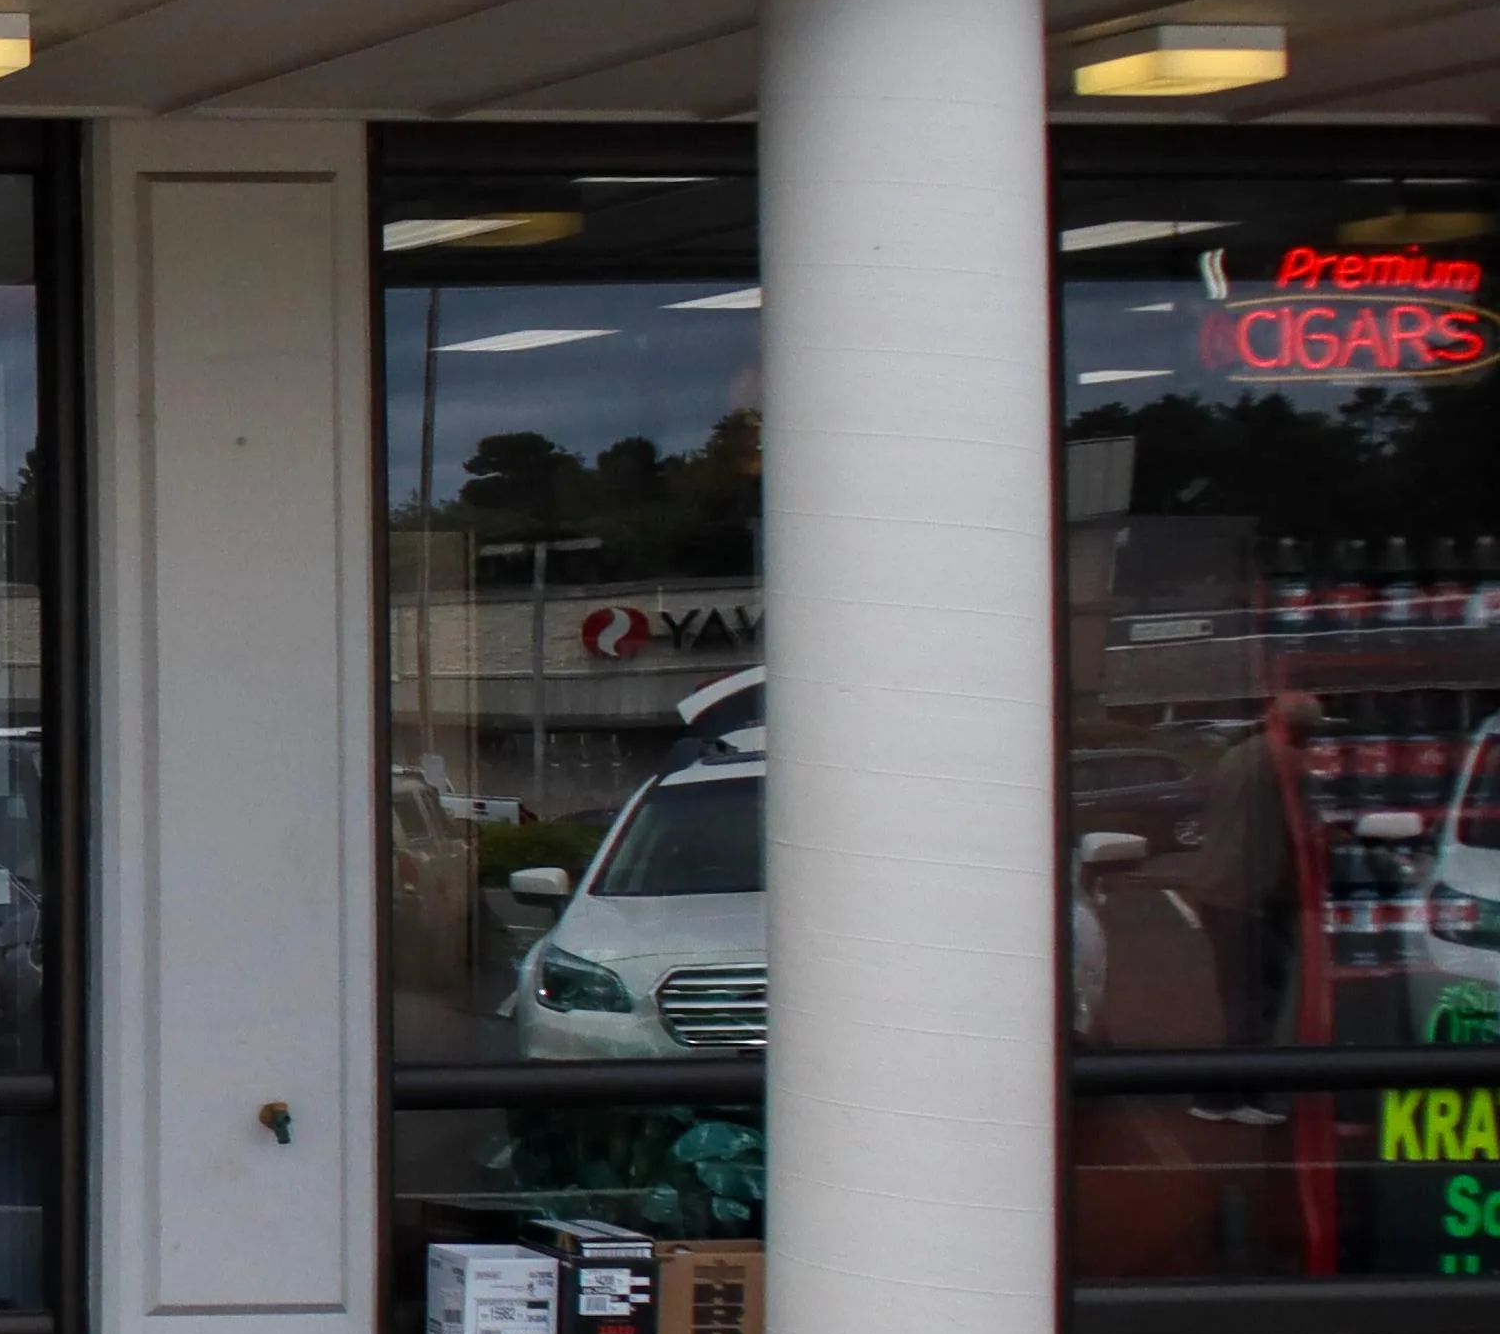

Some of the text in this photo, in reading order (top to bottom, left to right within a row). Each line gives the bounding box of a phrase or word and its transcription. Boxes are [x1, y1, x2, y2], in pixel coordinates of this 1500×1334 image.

[1276, 242, 1483, 292] Premium
[1236, 305, 1485, 369] CIGARS
[1381, 1087, 1500, 1161] KRA
